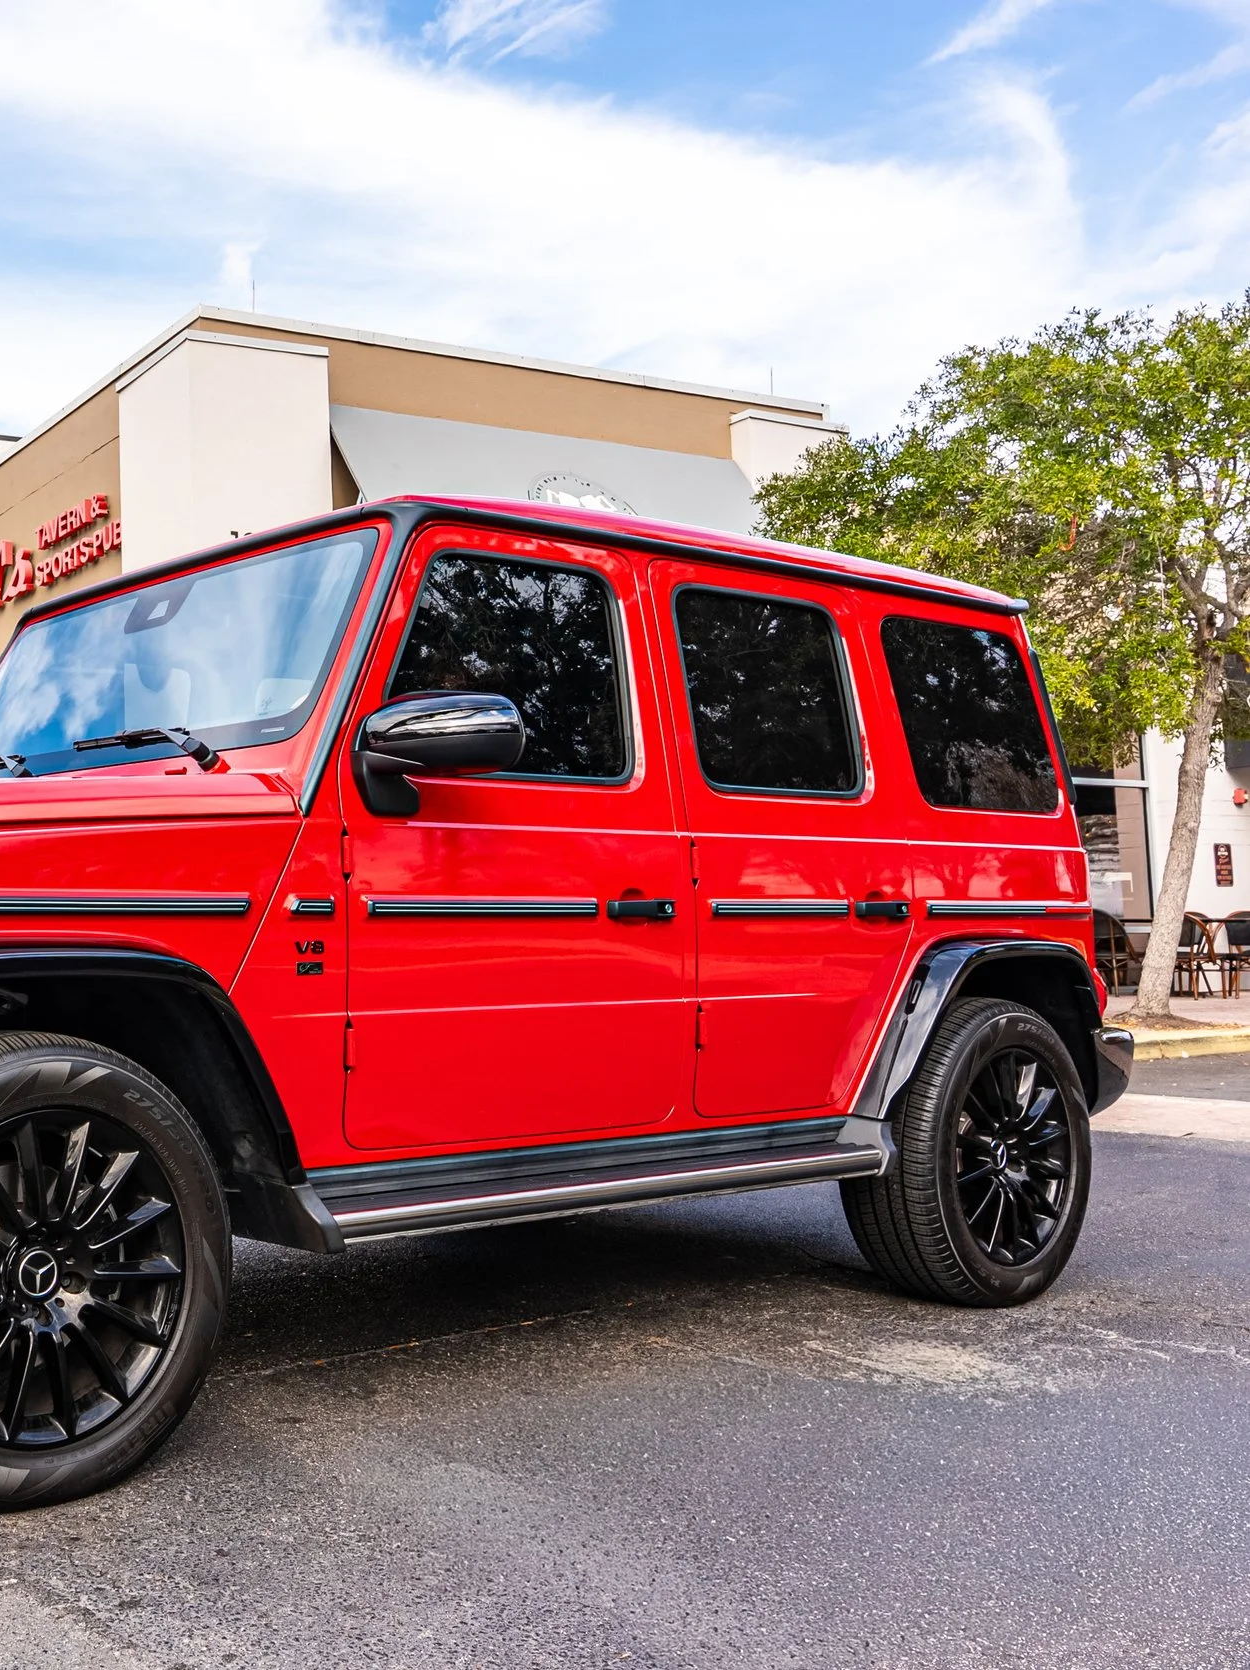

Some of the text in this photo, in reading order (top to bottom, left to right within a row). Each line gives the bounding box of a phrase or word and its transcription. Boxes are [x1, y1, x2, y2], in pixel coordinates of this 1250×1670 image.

[35, 492, 109, 550] TAVERN &
[35, 537, 94, 587] SPORTS
[295, 940, 325, 955] V8
